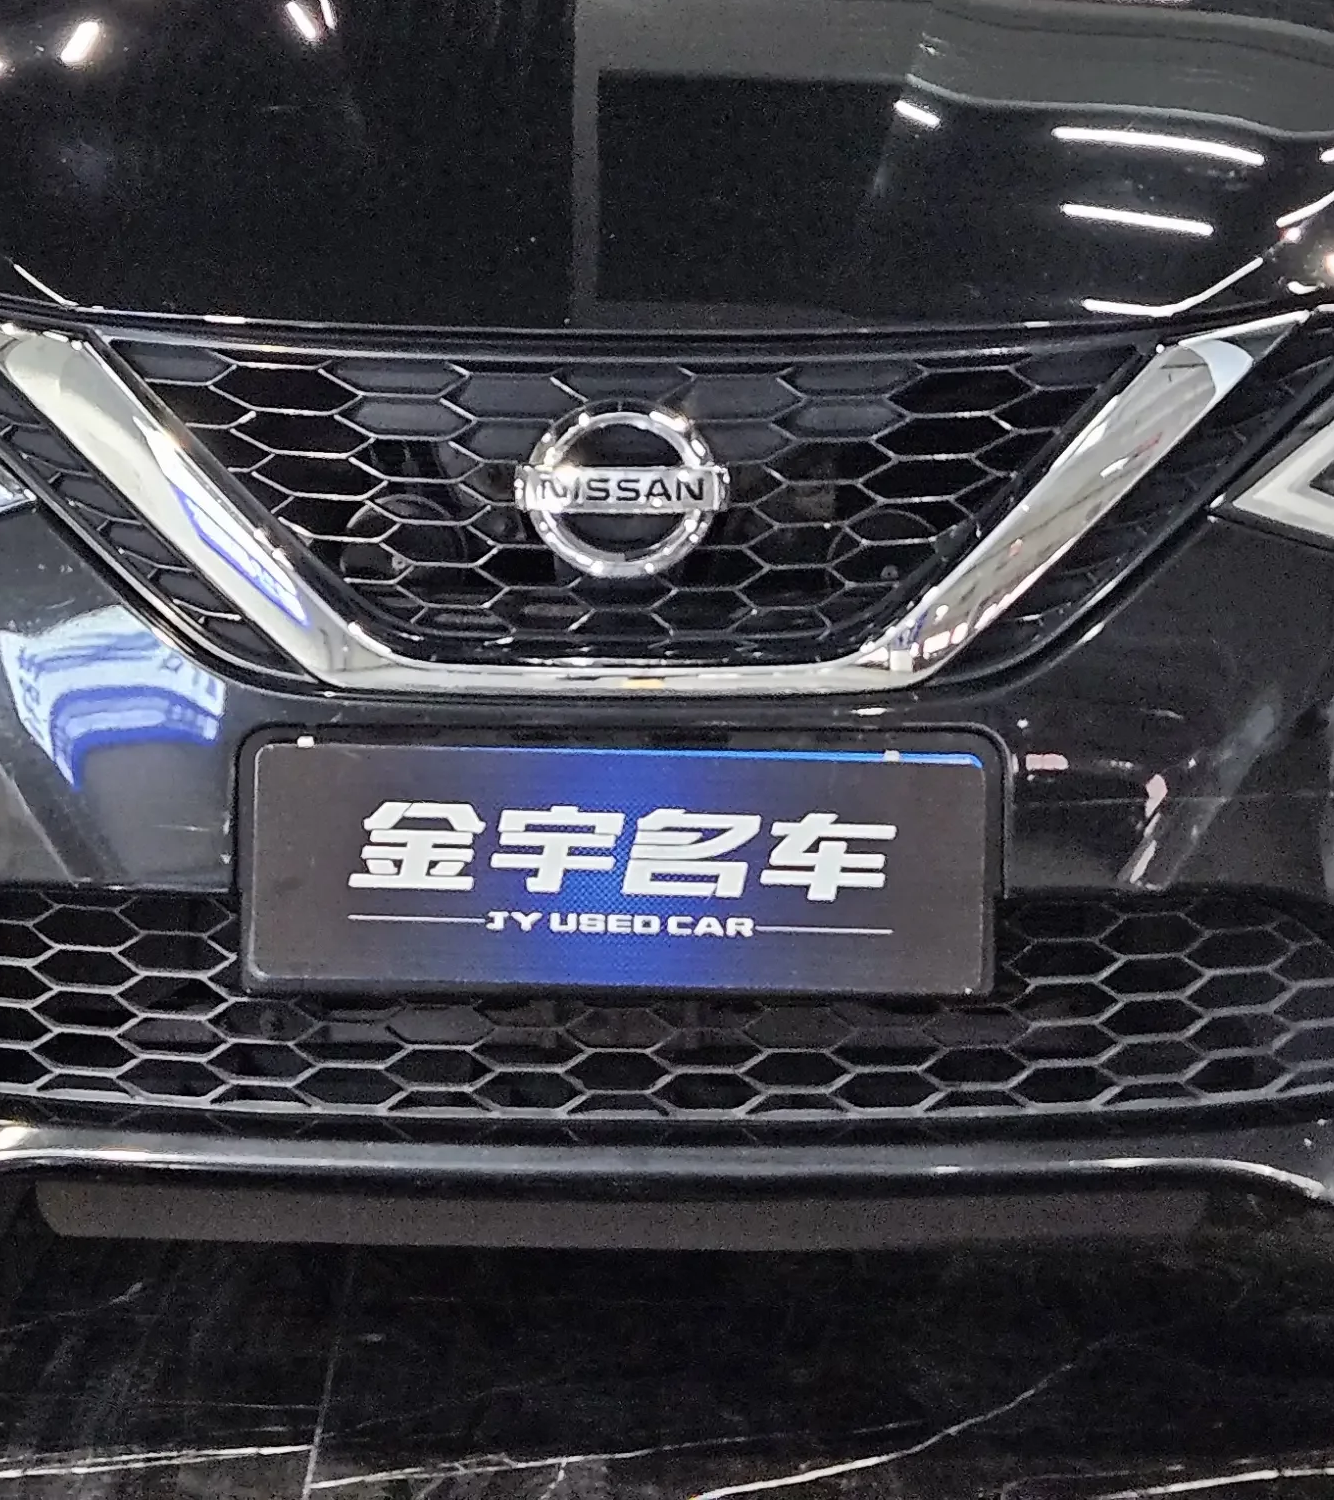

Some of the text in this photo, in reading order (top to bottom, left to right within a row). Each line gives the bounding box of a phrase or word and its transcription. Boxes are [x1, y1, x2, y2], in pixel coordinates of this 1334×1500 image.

[541, 477, 705, 501] NISSAN
[348, 801, 897, 901] 金宇名车
[485, 911, 755, 937] JY USED CAR
